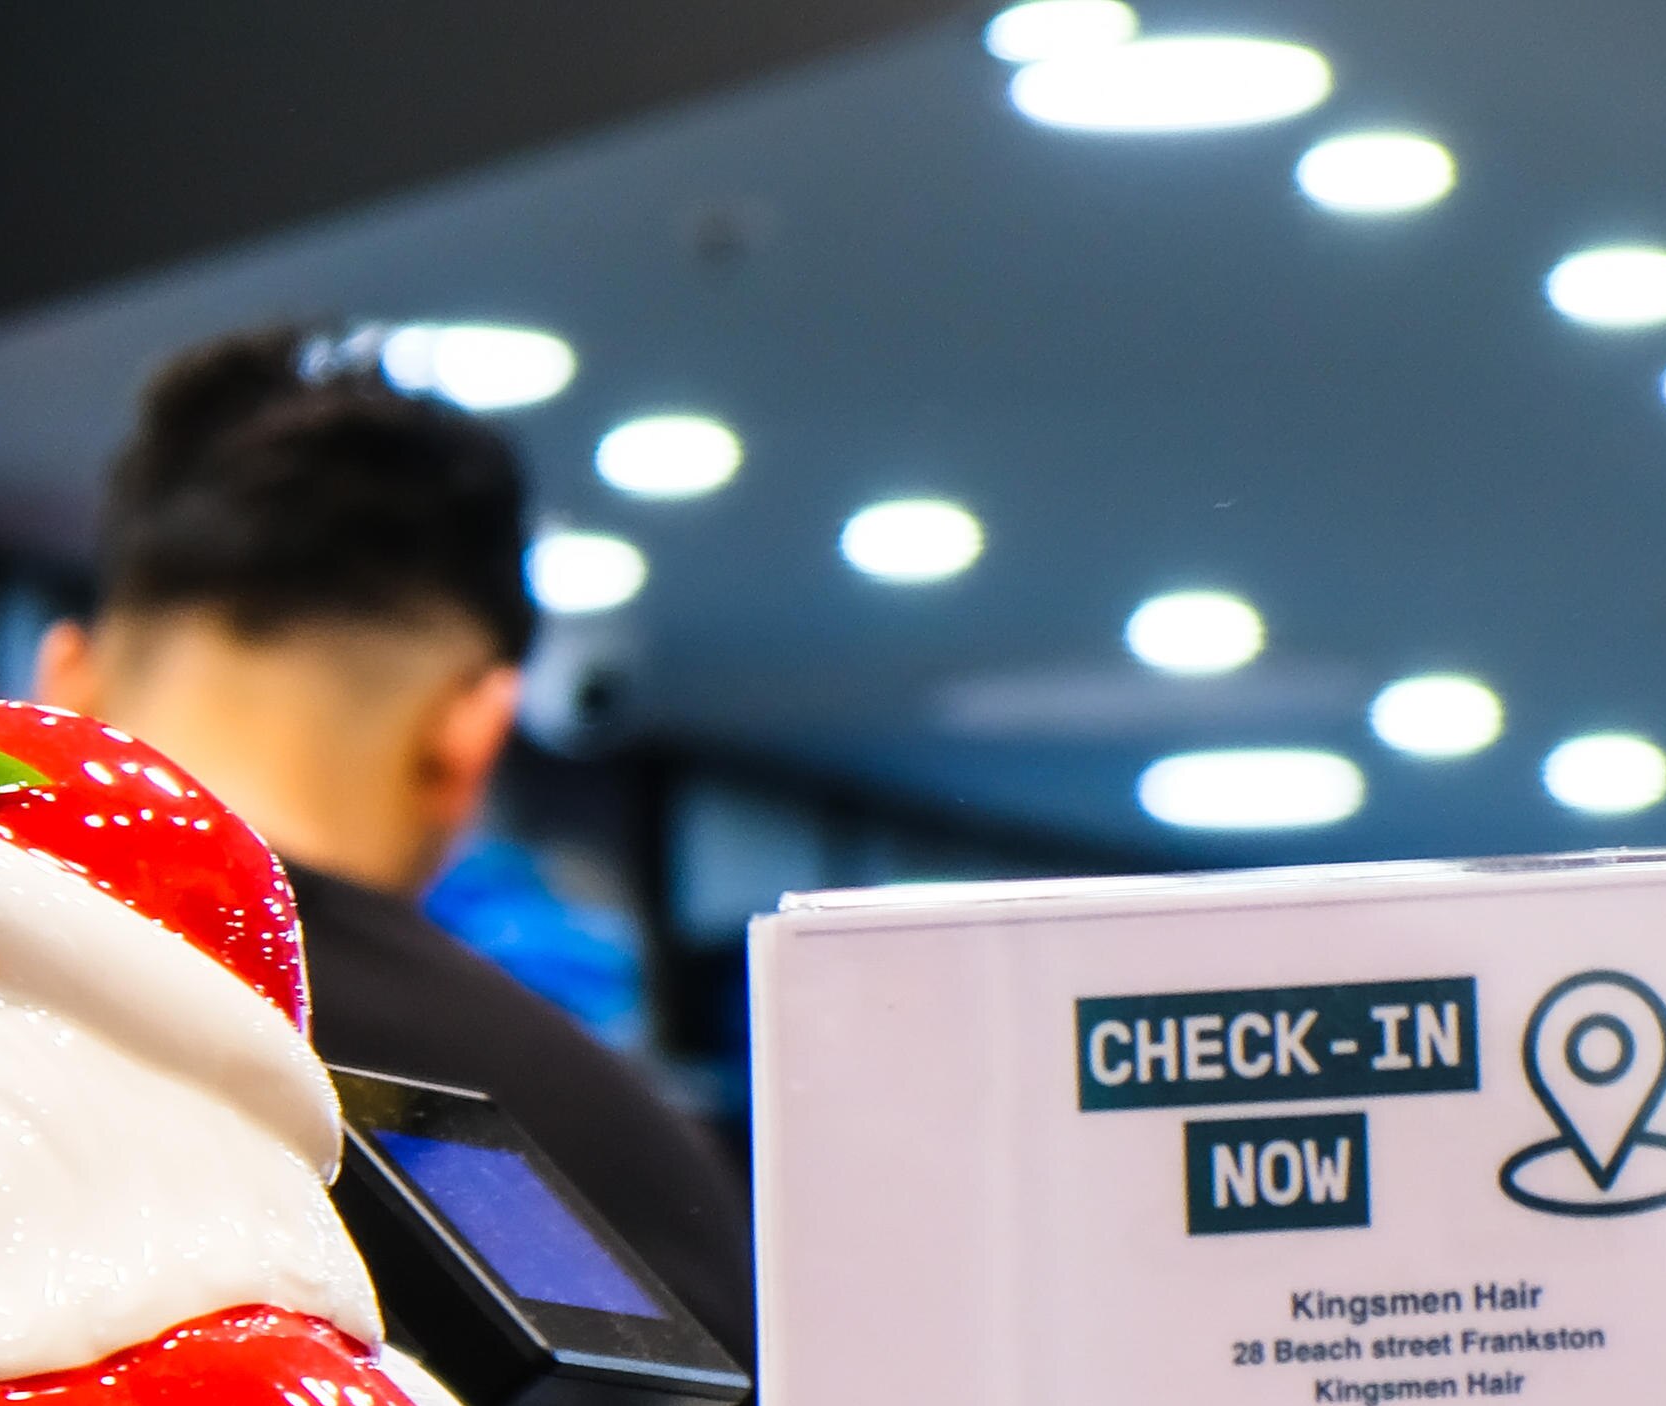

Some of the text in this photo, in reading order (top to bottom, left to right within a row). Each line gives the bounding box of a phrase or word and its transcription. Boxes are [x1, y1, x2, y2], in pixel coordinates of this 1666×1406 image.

[1088, 1001, 1462, 1087] CHECK-IN
[1212, 1137, 1352, 1208] NOW
[1290, 1280, 1543, 1325] Kingsmen Hair
[1232, 1326, 1606, 1366] 28 Beach street Frankston
[1314, 1371, 1525, 1406] Kingsmen Hair
